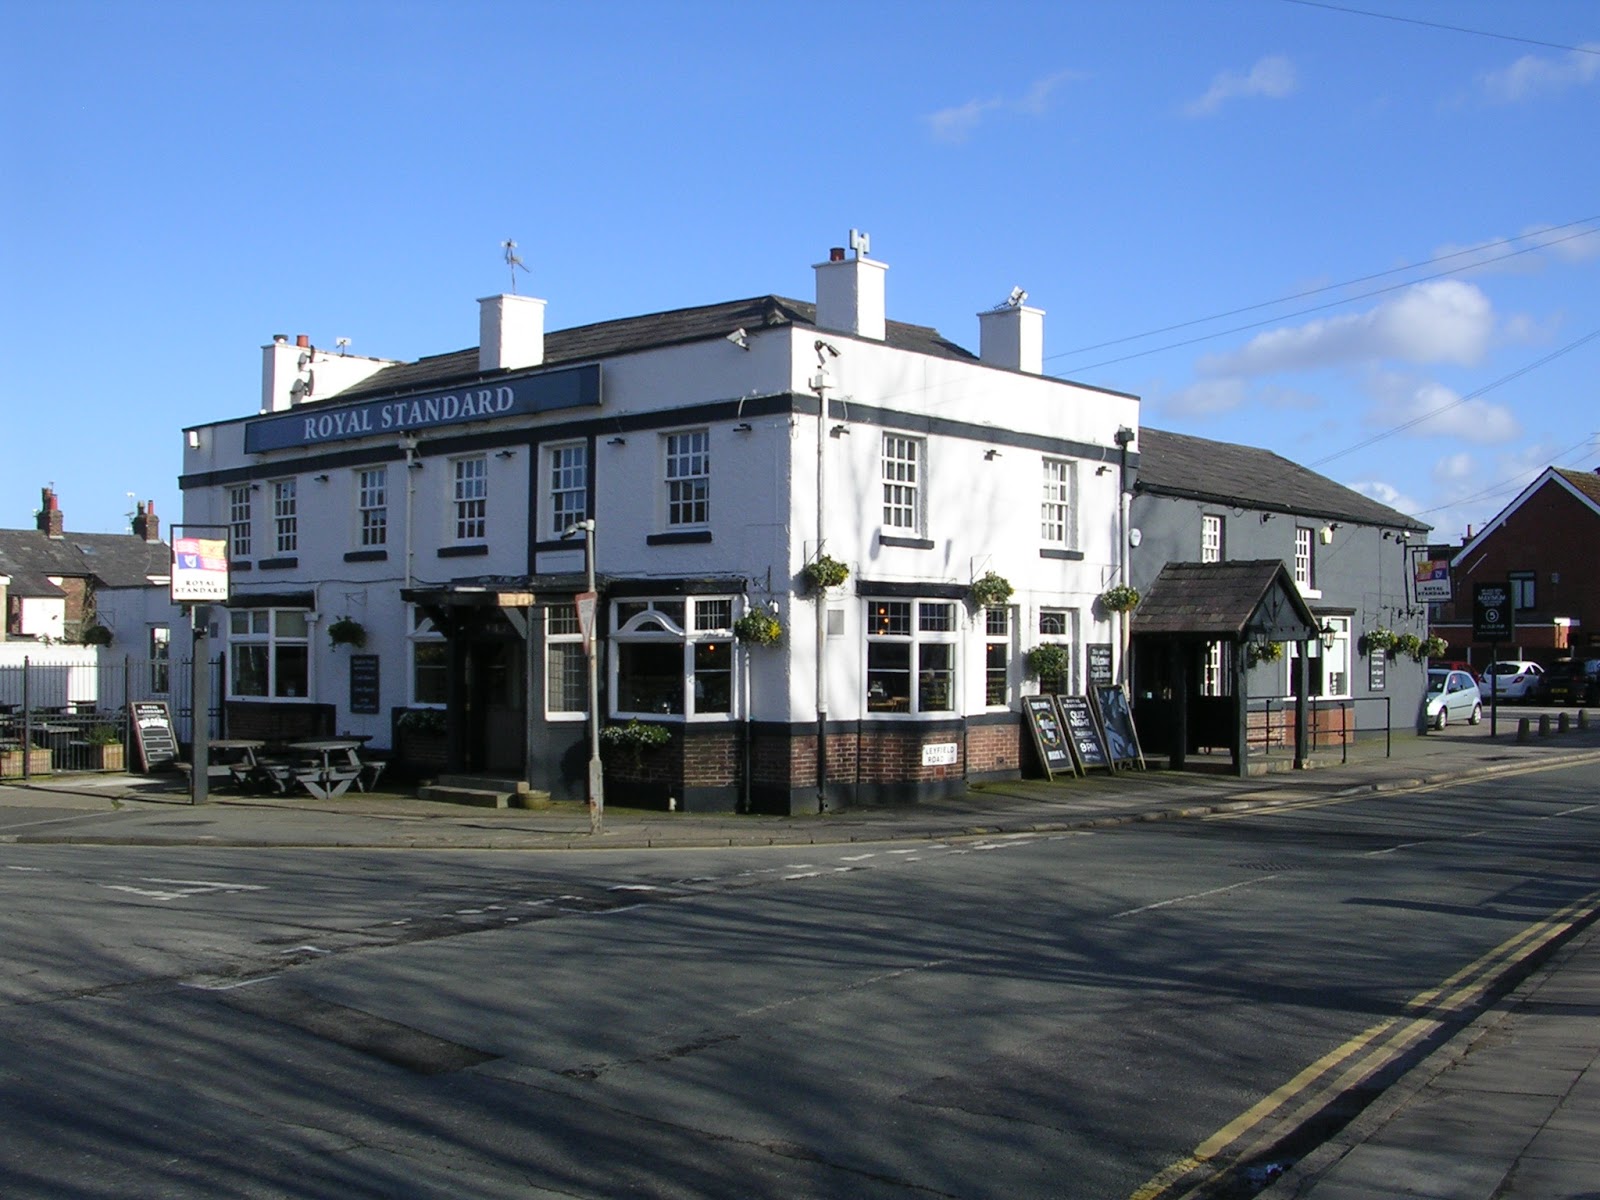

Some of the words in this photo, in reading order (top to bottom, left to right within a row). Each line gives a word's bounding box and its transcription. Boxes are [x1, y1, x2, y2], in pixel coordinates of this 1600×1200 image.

[303, 409, 373, 440] ROYAL
[381, 386, 515, 429] STANDARD
[1069, 710, 1086, 720] QUIZ
[1070, 718, 1090, 727] NIGHT
[925, 746, 955, 755] LEYFIELD
